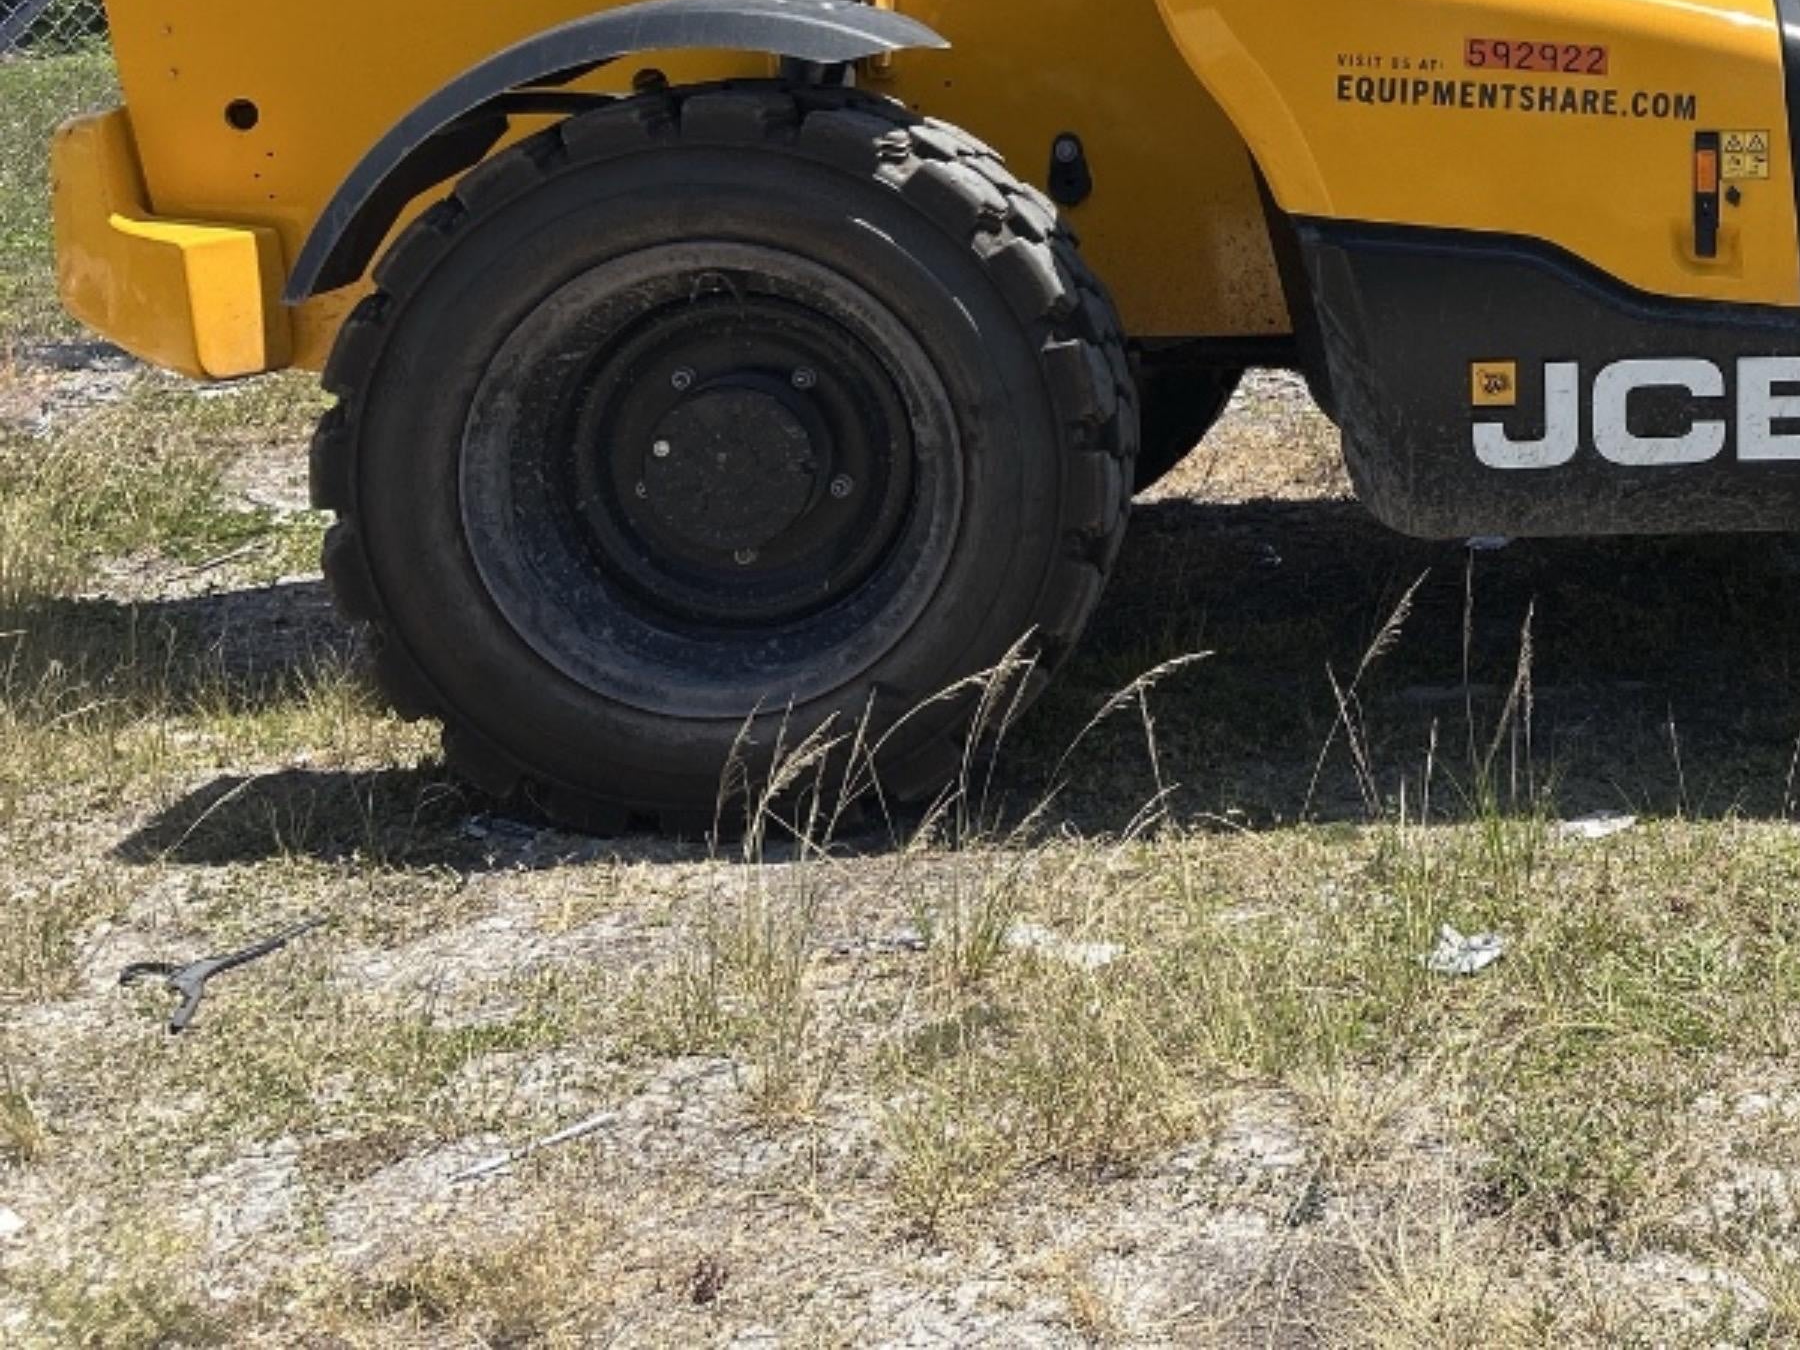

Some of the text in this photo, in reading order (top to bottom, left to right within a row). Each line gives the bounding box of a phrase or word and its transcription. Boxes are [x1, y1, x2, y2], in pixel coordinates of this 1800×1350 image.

[1336, 53, 1382, 70] VISIT
[1468, 38, 1606, 74] 592922
[1336, 74, 1697, 121] EQUIPMENTSHARE.COM
